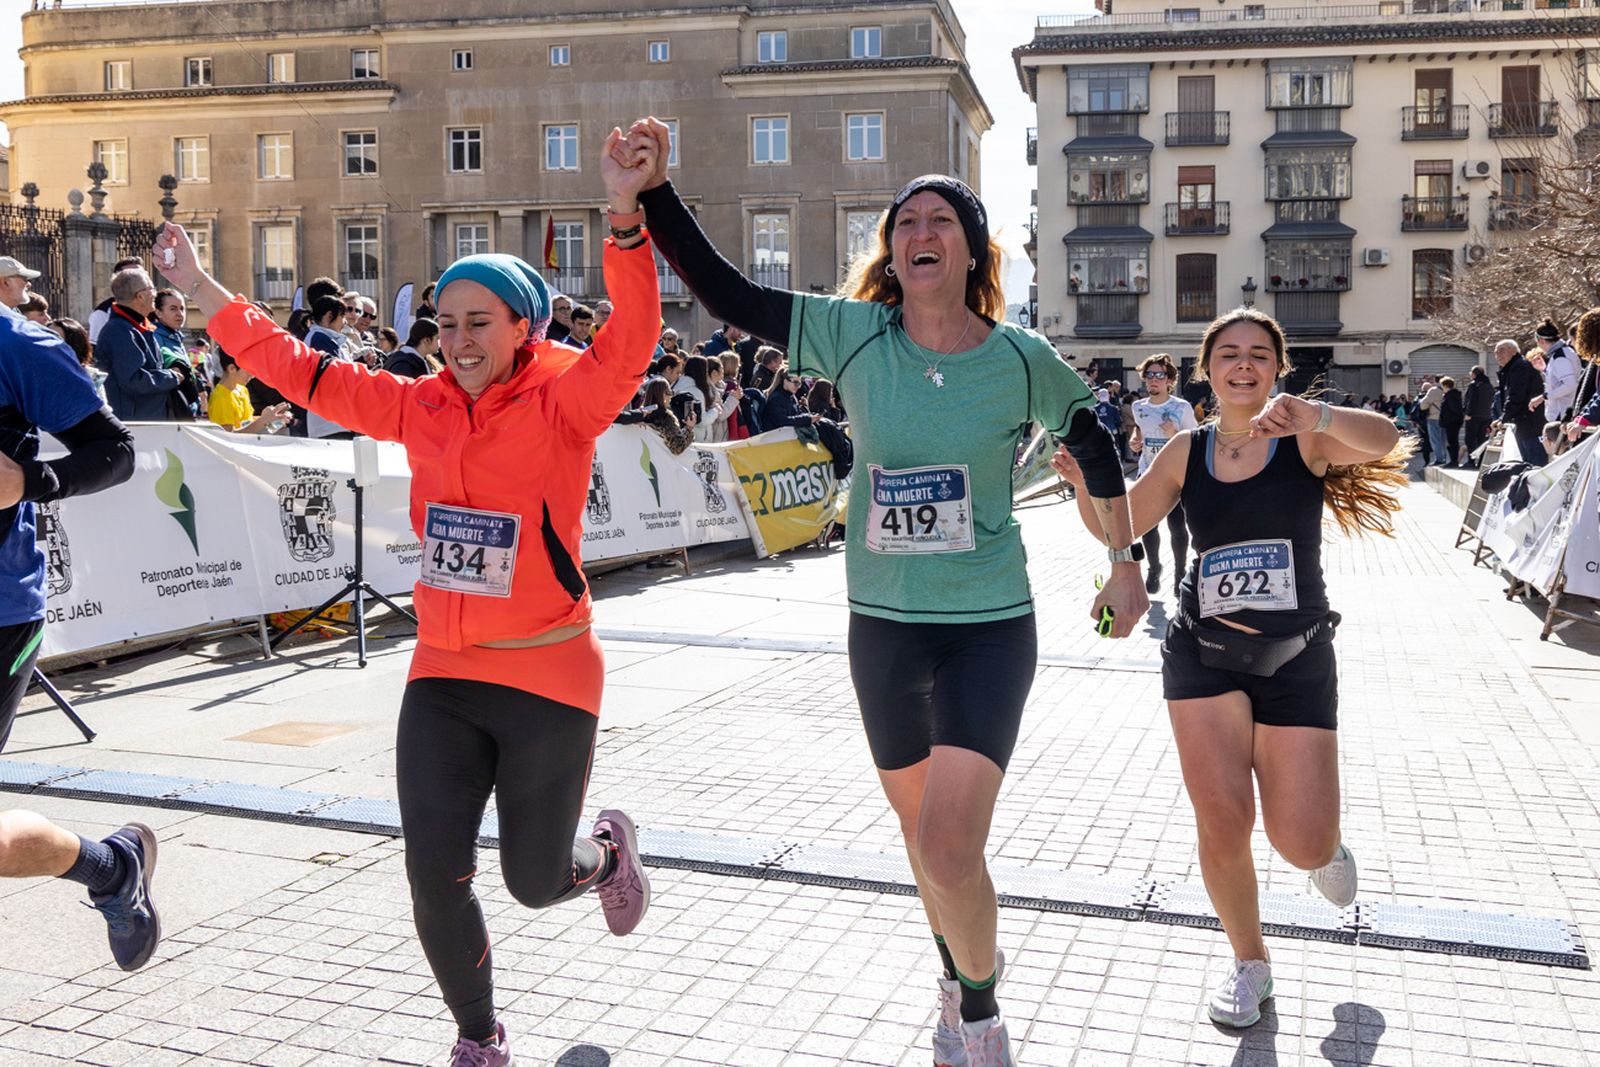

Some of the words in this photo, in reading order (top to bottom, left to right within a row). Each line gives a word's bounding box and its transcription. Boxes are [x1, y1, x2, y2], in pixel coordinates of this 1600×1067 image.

[909, 473, 951, 485] CAMINATA
[894, 487, 934, 503] MUERTE
[464, 515, 504, 529] CAMINATA
[881, 504, 938, 536] 419
[448, 526, 485, 542] MUERTE
[432, 541, 486, 575] 434
[1243, 546, 1278, 554] CAMINATA
[1232, 556, 1264, 569] MUERTE
[140, 566, 194, 584] Patronato
[229, 559, 242, 571] de
[274, 570, 315, 586] CIUDAD
[316, 568, 331, 581] DE
[211, 574, 233, 588] Jaén
[1217, 570, 1271, 598] 622
[46, 608, 66, 624] DE
[68, 599, 103, 620] JAÉN
